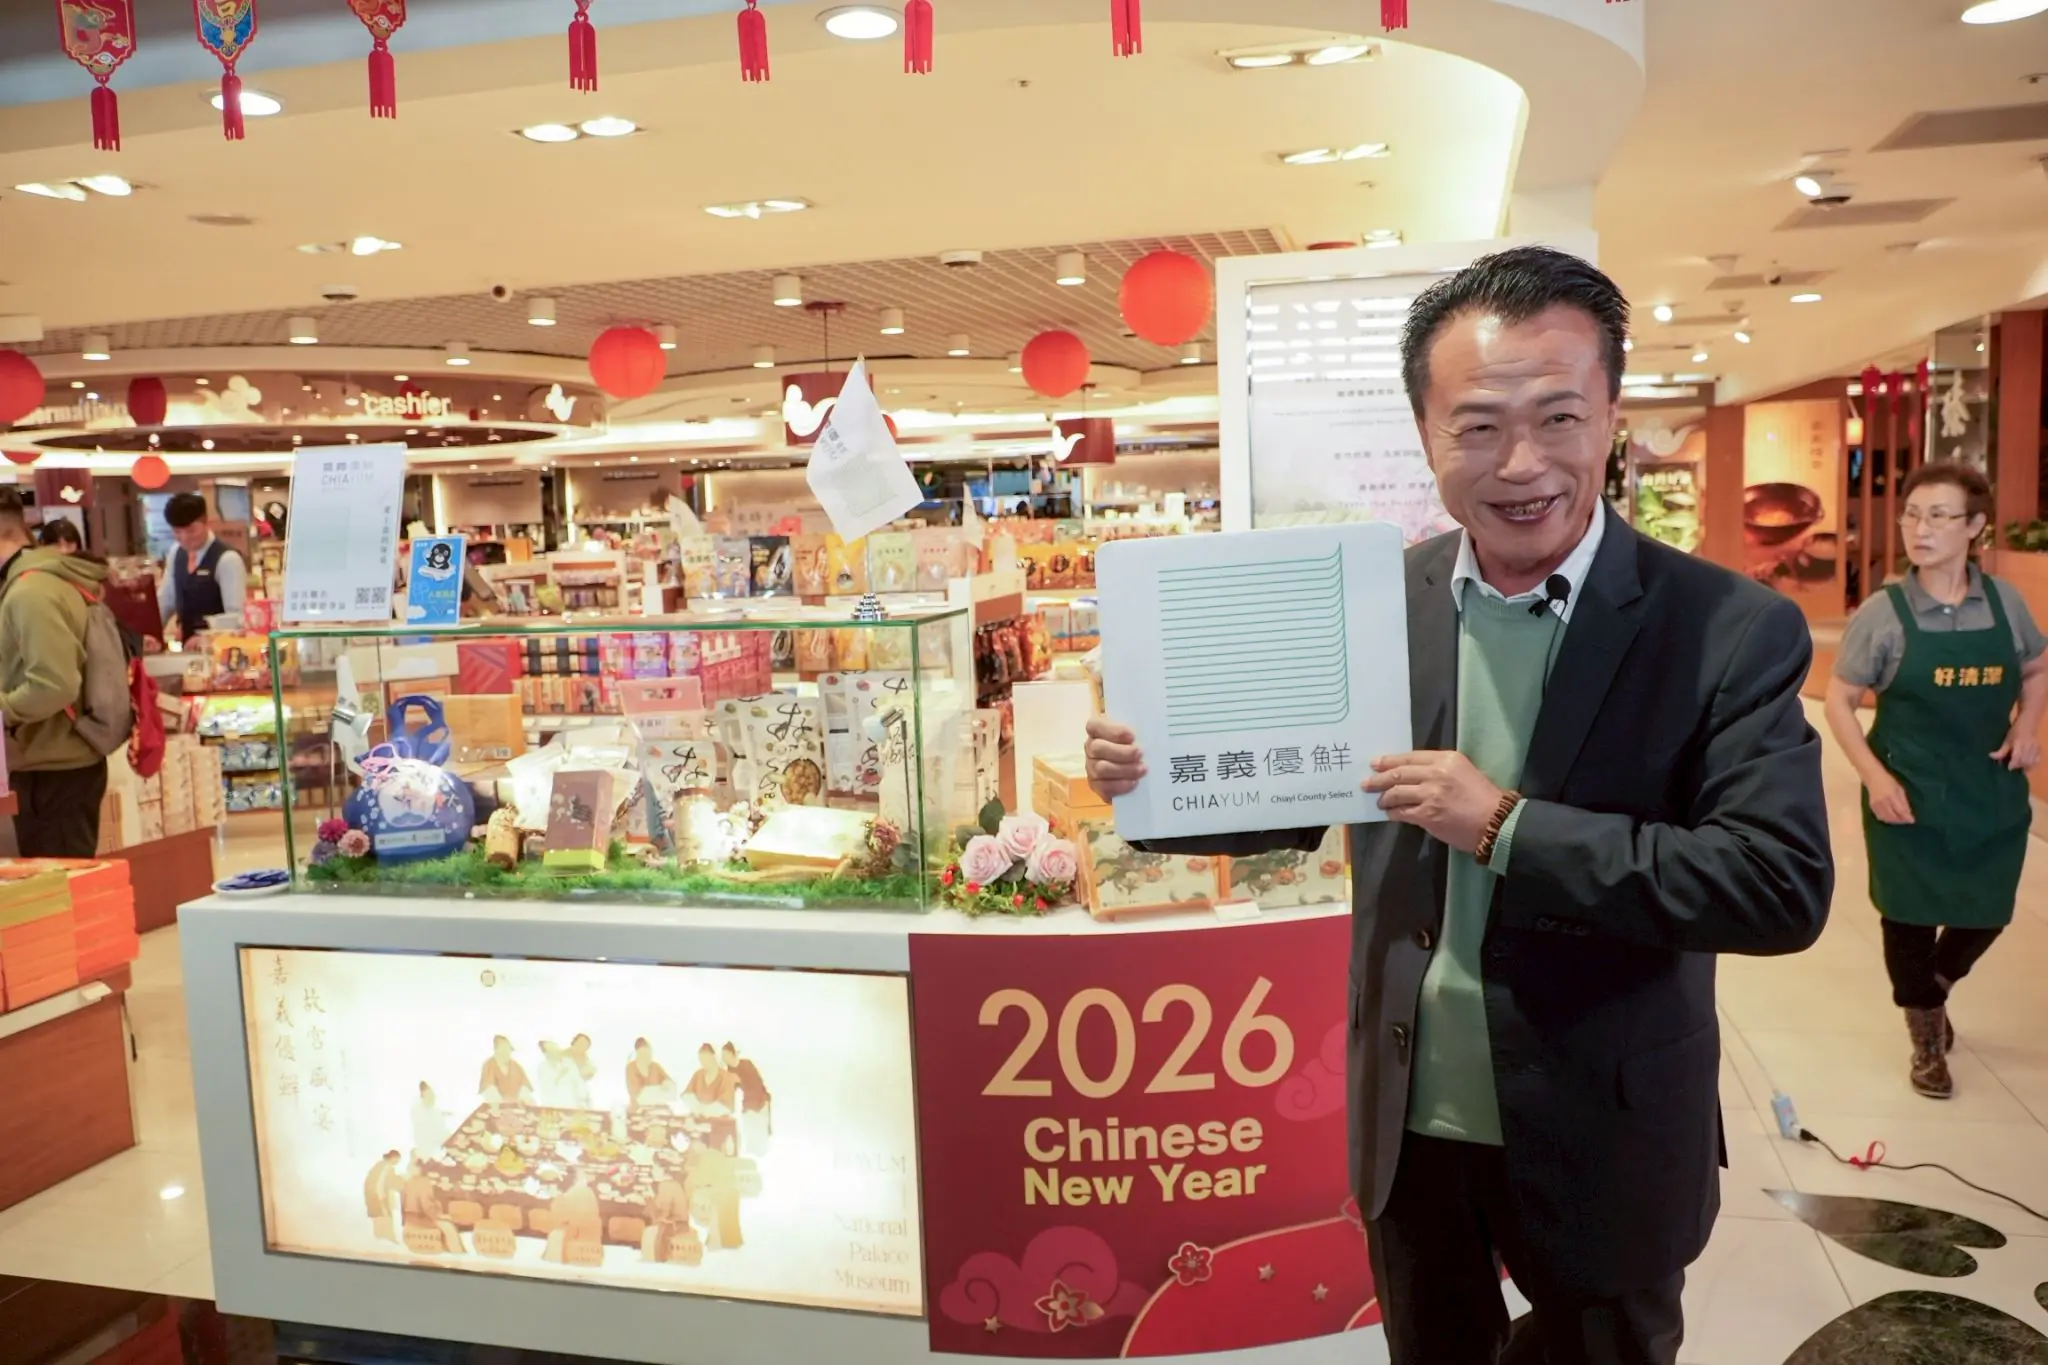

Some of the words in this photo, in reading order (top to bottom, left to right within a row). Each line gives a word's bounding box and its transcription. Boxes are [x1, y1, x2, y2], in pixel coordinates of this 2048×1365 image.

[364, 390, 452, 416] cashier
[1168, 742, 1354, 785] 嘉義優鮮
[1172, 790, 1261, 811] CHIAYUM
[1297, 791, 1327, 803] County
[1328, 790, 1354, 800] Select
[977, 976, 1295, 1099] 2026
[1023, 1116, 1264, 1162] Chinese
[1023, 1167, 1133, 1206] New
[1149, 1163, 1267, 1202] Year
[834, 1210, 909, 1238] National
[848, 1241, 910, 1265] Palace
[835, 1267, 912, 1296] Museum
